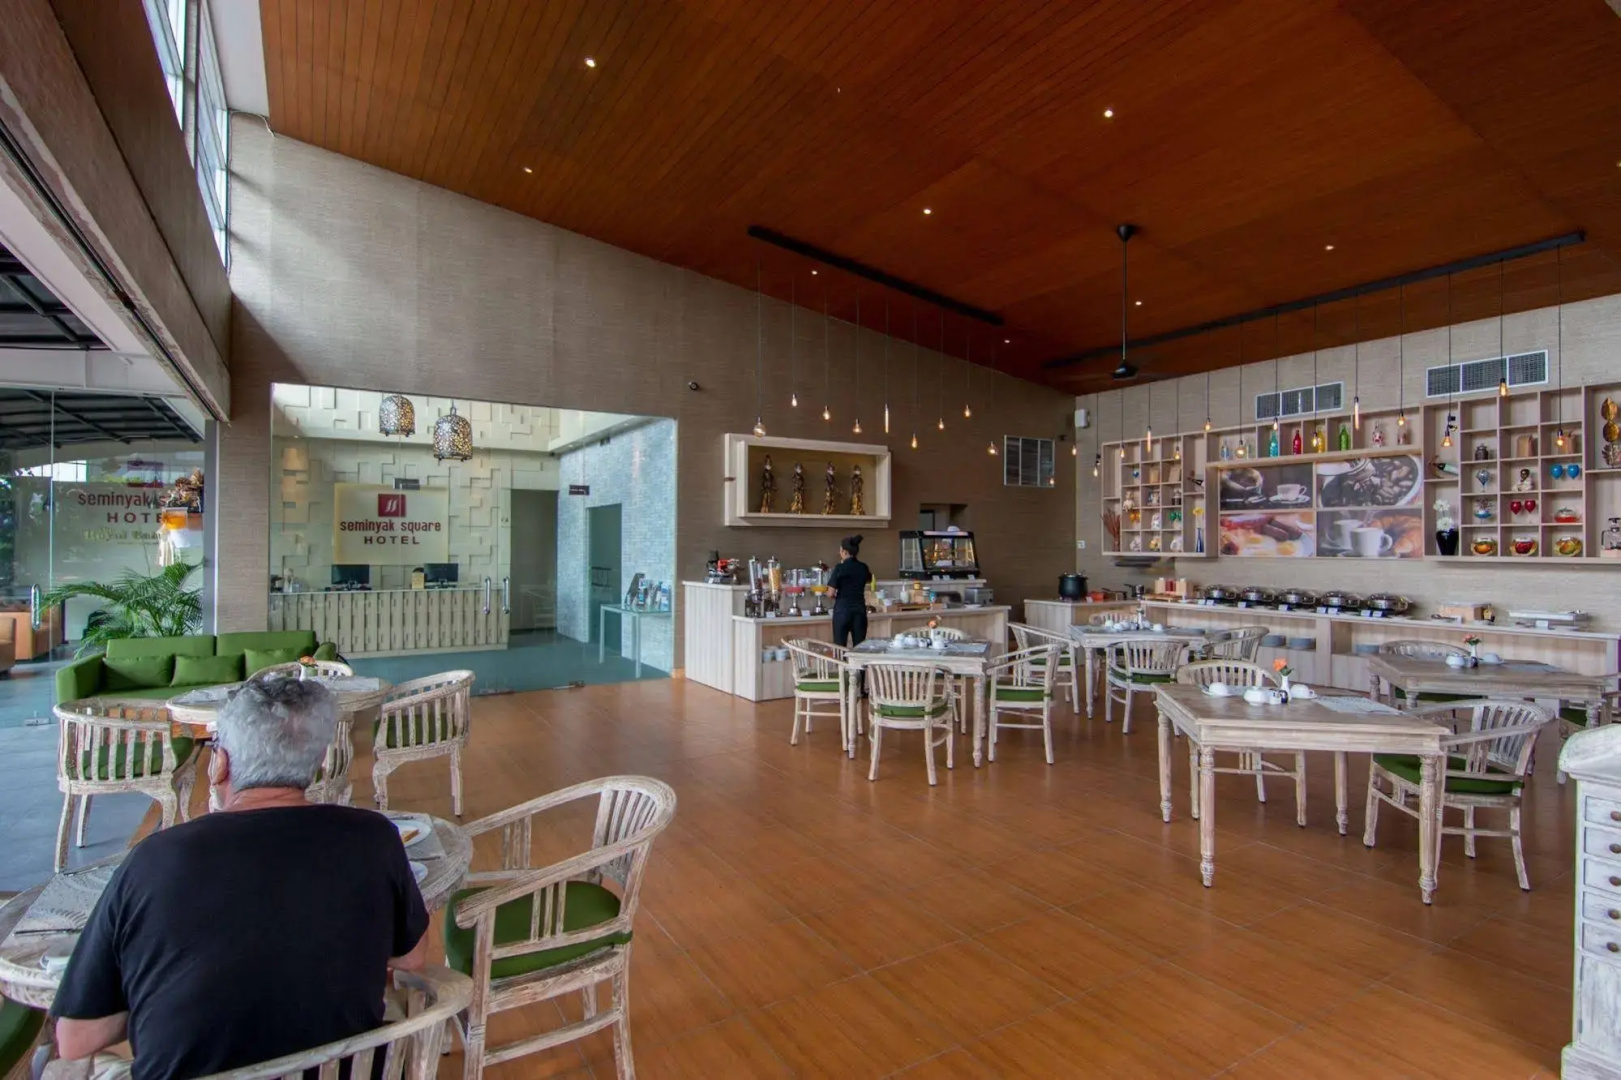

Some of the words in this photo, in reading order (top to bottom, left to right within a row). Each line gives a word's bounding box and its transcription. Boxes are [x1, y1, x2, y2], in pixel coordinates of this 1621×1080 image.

[78, 491, 150, 509] seminyak
[107, 512, 164, 523] HOTE
[340, 519, 395, 533] seminyak
[400, 521, 441, 533] square
[363, 536, 420, 544] HOTEL
